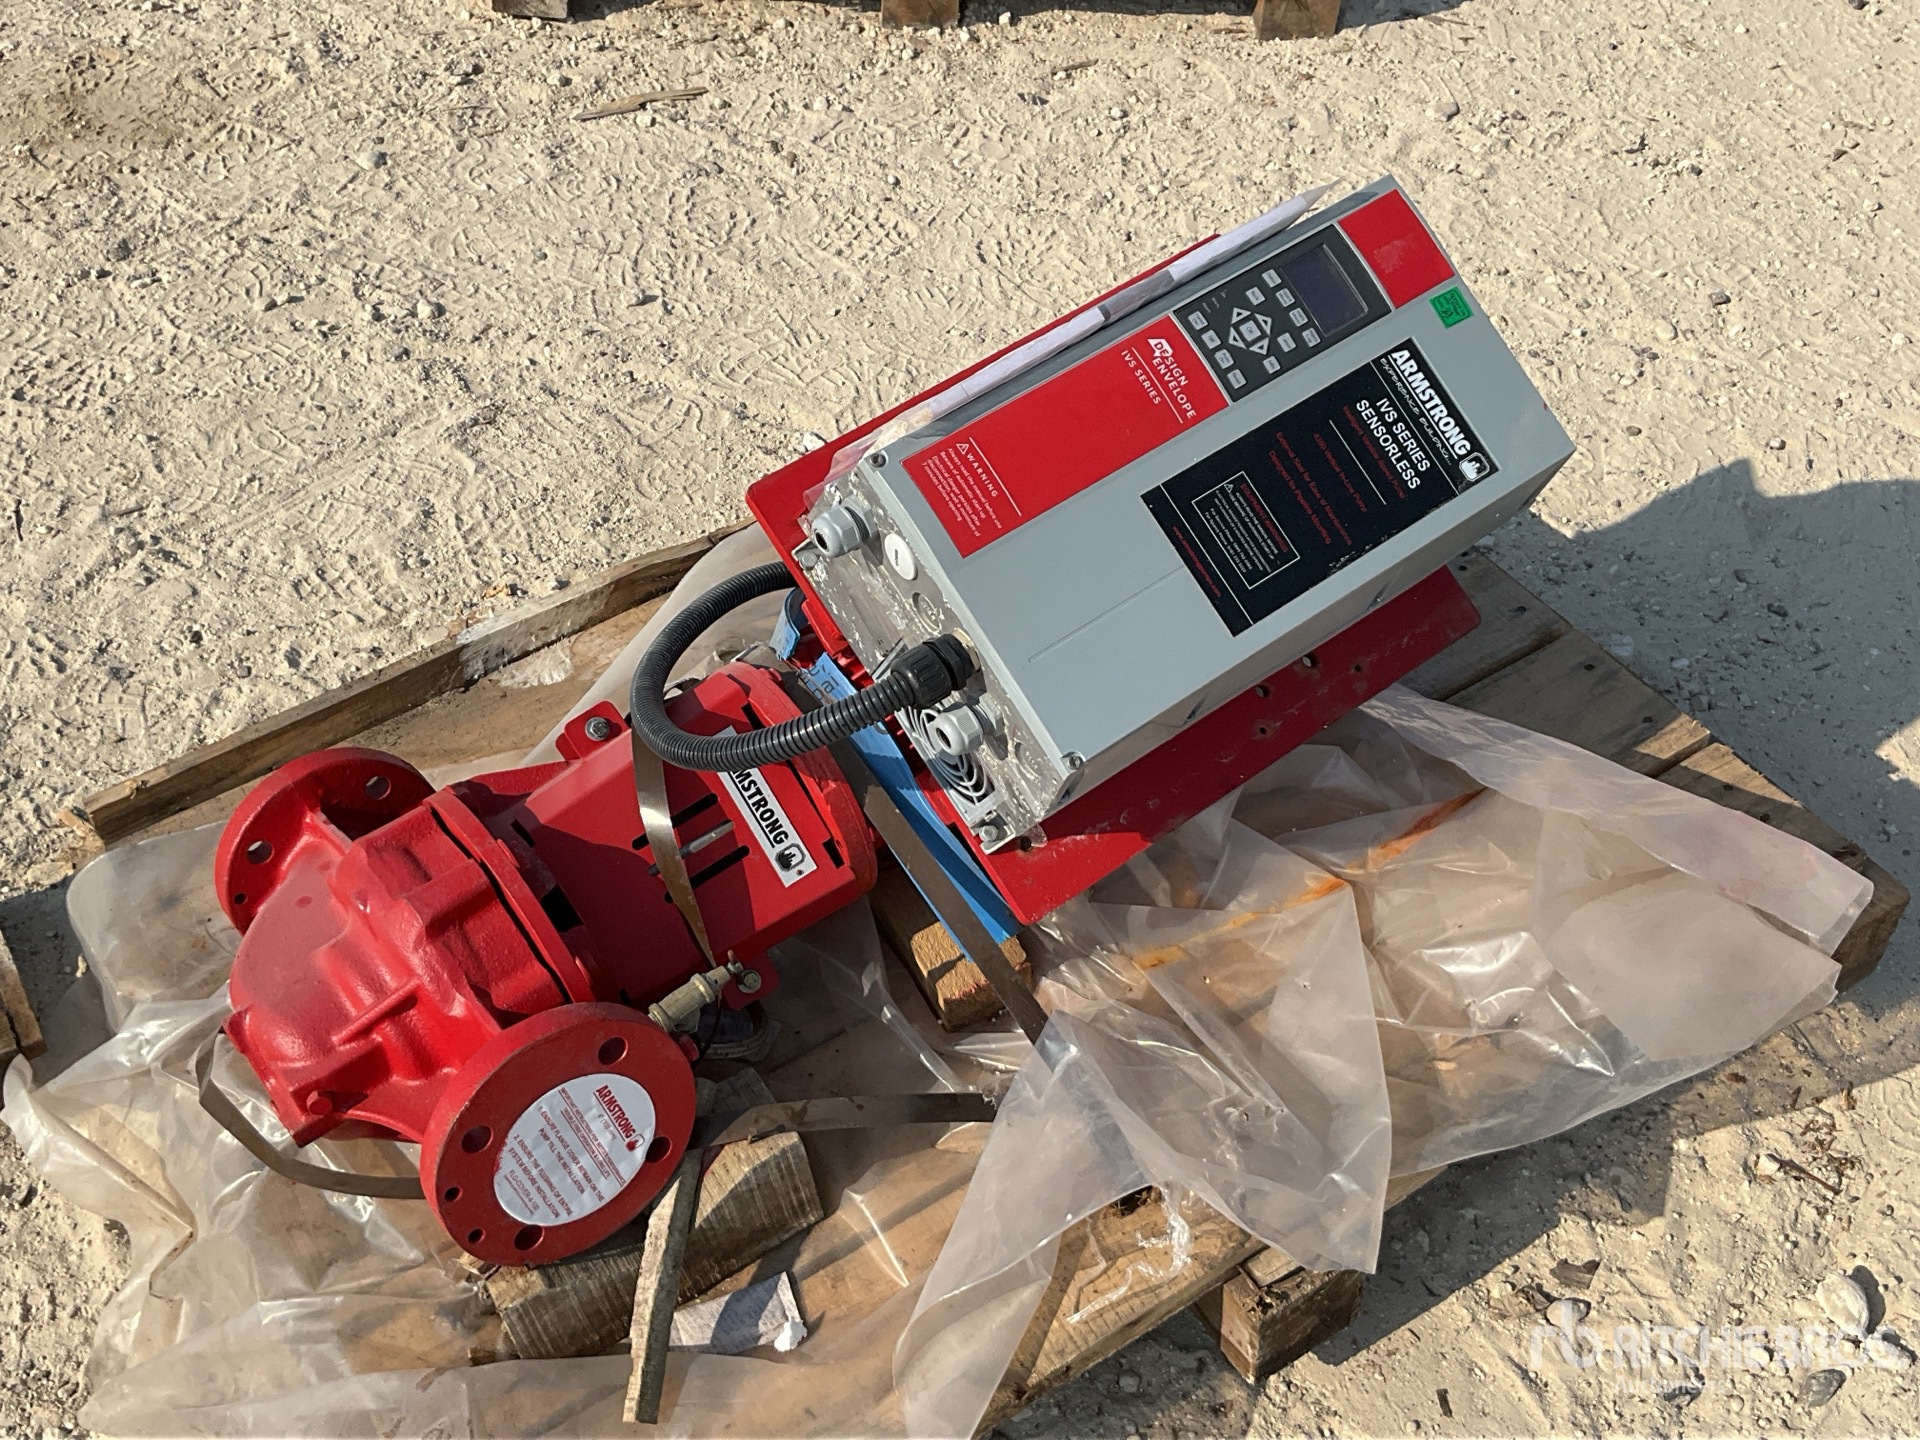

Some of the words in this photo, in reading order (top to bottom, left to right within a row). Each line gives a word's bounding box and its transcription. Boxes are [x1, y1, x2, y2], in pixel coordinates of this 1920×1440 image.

[1120, 349, 1136, 368] IVS
[1133, 368, 1161, 405] SERIES
[1151, 356, 1196, 419] ENVELOPE
[1153, 340, 1188, 386] DESIGN
[1378, 357, 1421, 416] EXPERIENCE
[1375, 396, 1398, 423] IVS
[1390, 420, 1431, 472] SERIES
[1390, 349, 1472, 458] ARMSTRONG
[965, 452, 998, 497] WARNING
[1275, 431, 1296, 458] External
[1301, 471, 1312, 482] for
[1308, 481, 1322, 499] Ease
[1354, 397, 1421, 490] SENSORLESS
[923, 465, 939, 485] minutes
[936, 484, 949, 501] before
[946, 500, 963, 521] opening
[931, 454, 949, 478] Electrical
[945, 477, 960, 495] danger
[957, 494, 972, 514] persists
[969, 513, 980, 526] after
[939, 450, 955, 469] Beware
[954, 474, 973, 499] automatic
[970, 498, 981, 511] start
[978, 510, 986, 519] up
[947, 447, 961, 465] Always
[958, 464, 969, 477] read
[965, 476, 974, 485] the
[971, 484, 986, 503] manual
[982, 502, 996, 519] before
[993, 518, 1002, 529] use
[948, 491, 959, 504] wait
[958, 507, 976, 531] minimum
[1287, 479, 1297, 490] for
[1351, 492, 1368, 513] Pump
[560, 1086, 577, 1109] IMPORTANT
[574, 1108, 593, 1134] INSTRUCTIONS
[590, 1133, 598, 1142] FOR
[595, 1141, 608, 1157] BETTER
[605, 1156, 626, 1185] PERFORMANCE
[562, 1107, 575, 1124] TROUBLE
[572, 1123, 582, 1133] FREE
[579, 1132, 596, 1155] OPERATION
[595, 1083, 637, 1139] ARMSTRONG
[507, 1147, 525, 1168] SYSTEM
[520, 1165, 538, 1186] BEFORE
[534, 1184, 560, 1218] INSTALLATION
[516, 1139, 533, 1160] ENSURE
[530, 1158, 540, 1169] THE
[536, 1168, 556, 1192] FLUSHING
[552, 1190, 561, 1199] OF
[557, 1197, 573, 1216] ENTIRE
[537, 1127, 550, 1142] PUMP
[547, 1140, 558, 1153] TILL
[554, 1151, 564, 1162] THE
[560, 1161, 586, 1194] INSTALLATION
[539, 1110, 556, 1131] ENSURE
[552, 1129, 569, 1150] FLANGE
[566, 1149, 580, 1166] COVER
[576, 1165, 592, 1184] REMAIN
[589, 1182, 597, 1191] ON
[594, 1190, 604, 1202] THE
